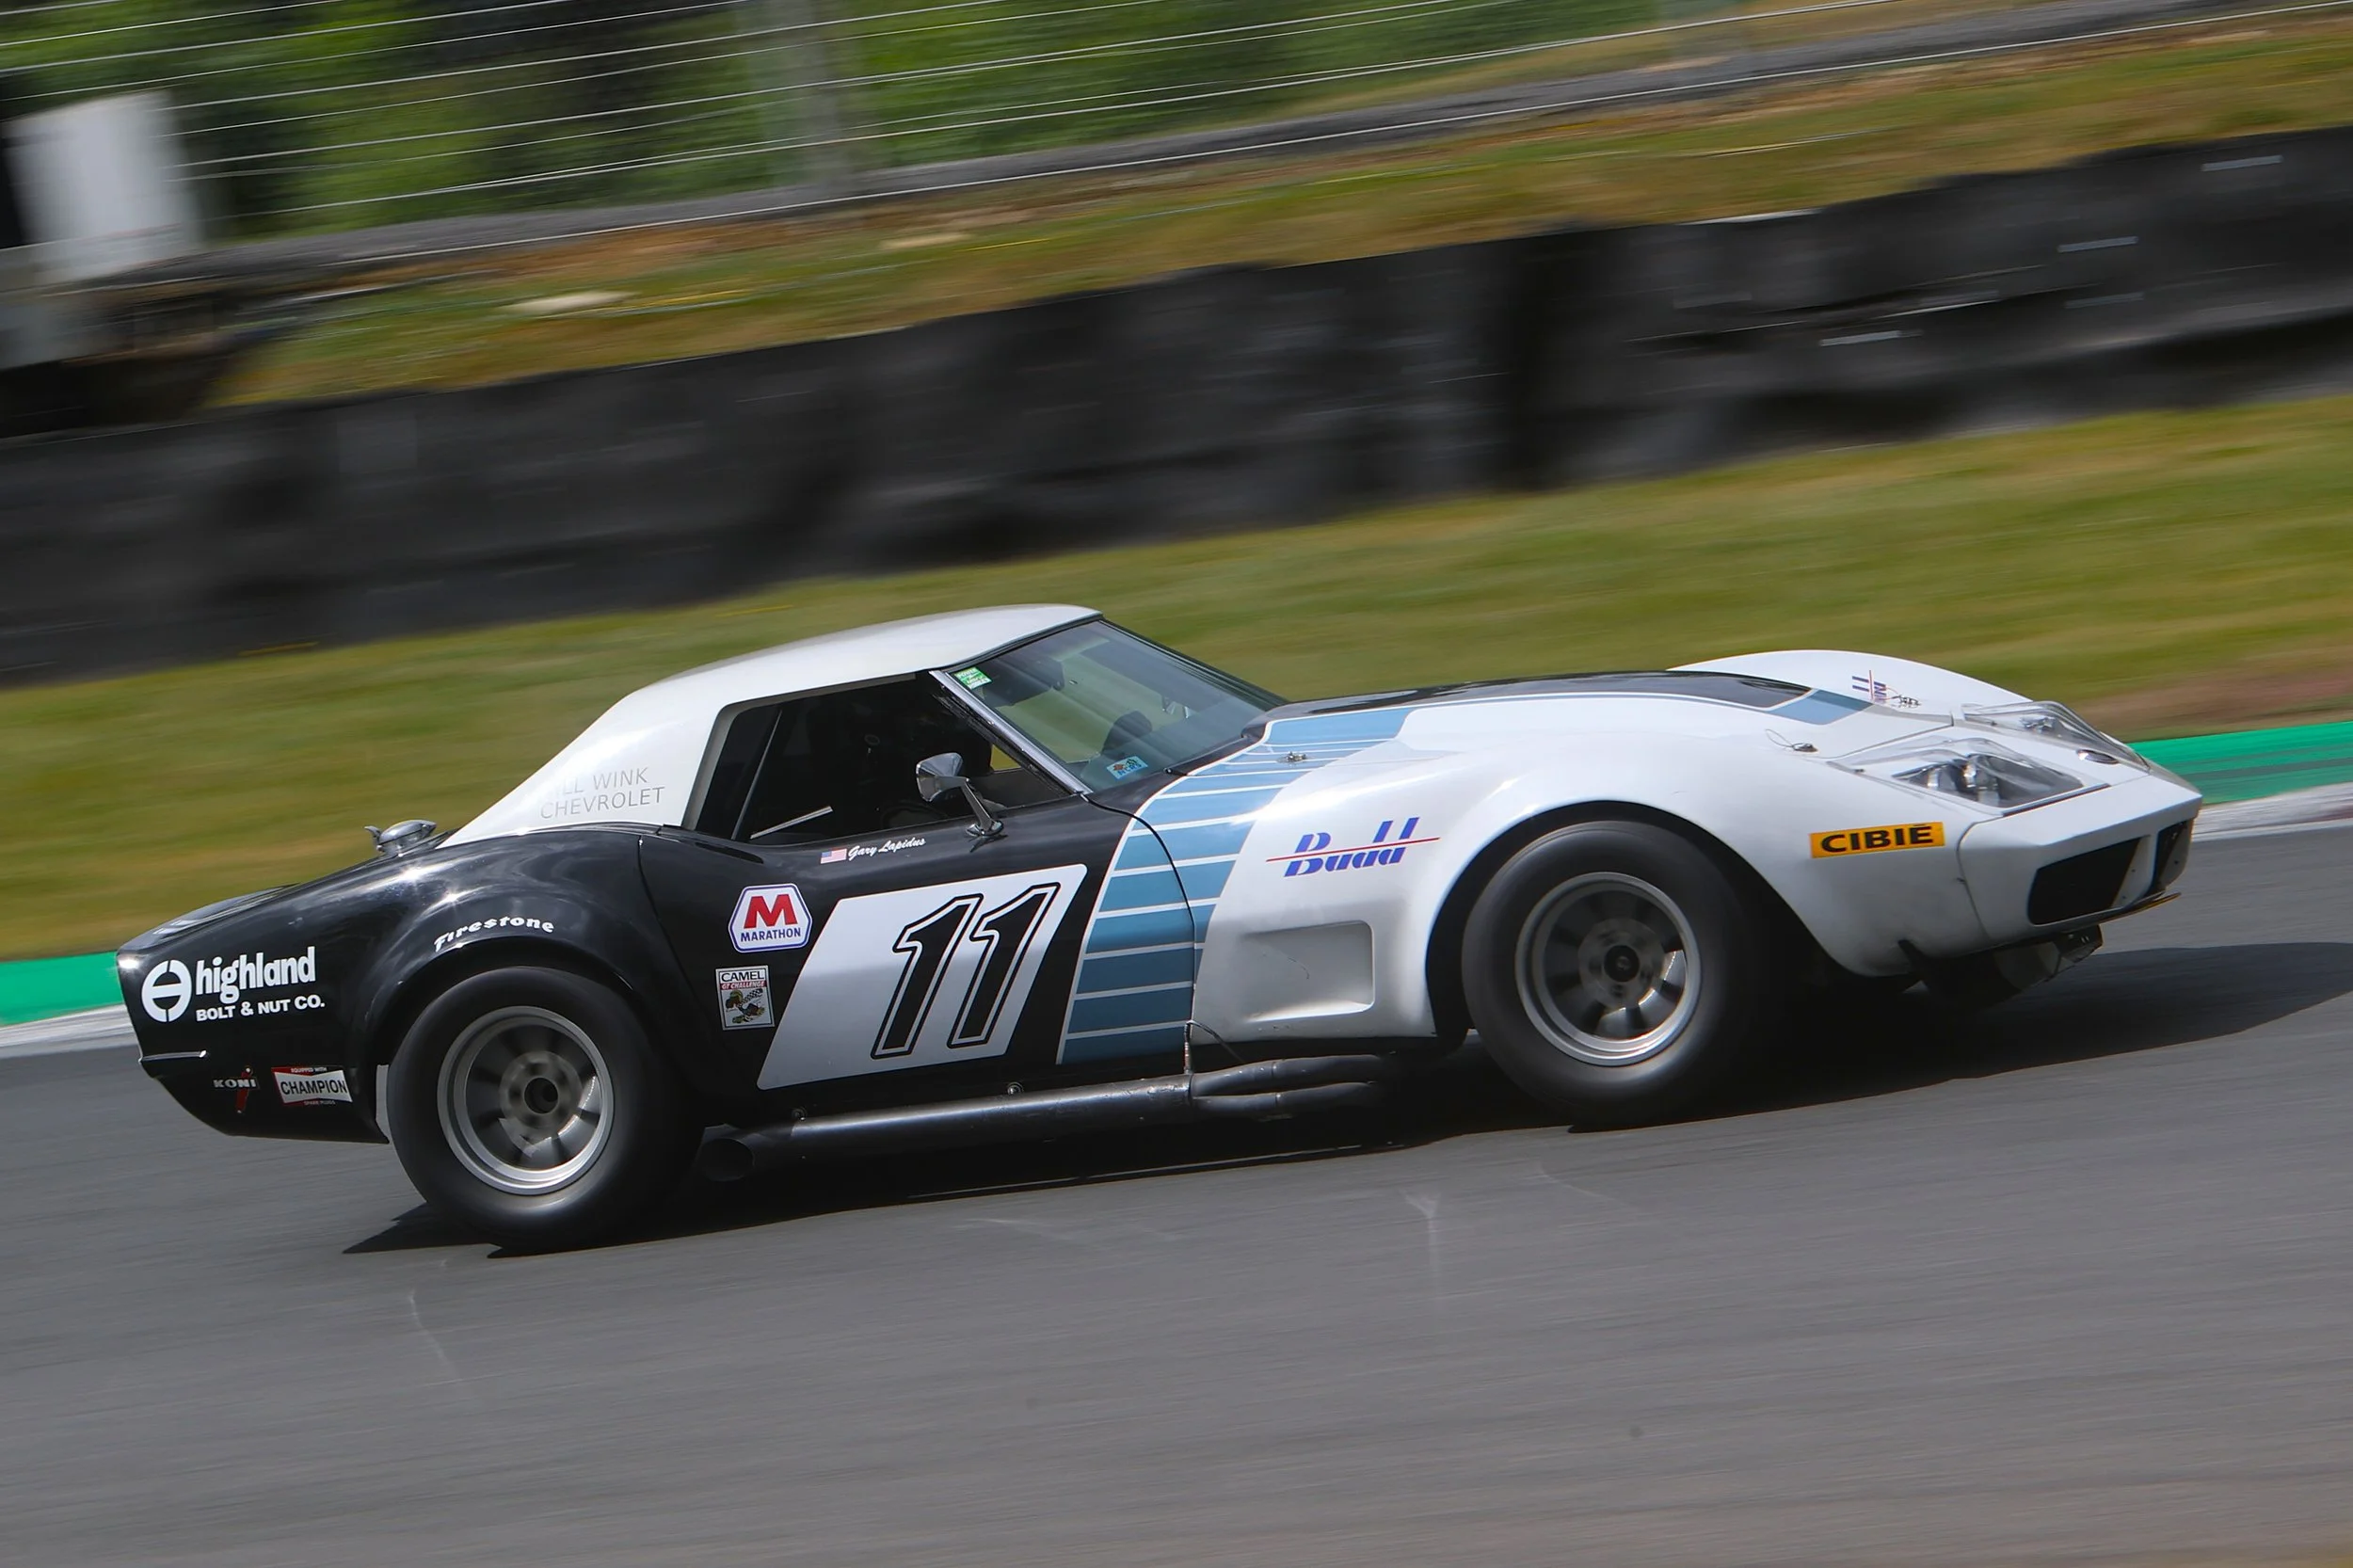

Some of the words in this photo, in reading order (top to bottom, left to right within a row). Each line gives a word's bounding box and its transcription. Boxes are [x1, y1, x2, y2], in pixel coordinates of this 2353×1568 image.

[593, 767, 648, 790] WINK
[540, 787, 664, 819] CHEVROLET
[848, 846, 877, 861] Gary
[878, 837, 926, 853] Lapidus
[1284, 817, 1420, 877] Budd
[744, 894, 798, 929] M
[434, 916, 554, 952] Firestone
[741, 927, 801, 942] MARATHON
[196, 946, 316, 1004] highland
[721, 970, 764, 982] CAMEL
[871, 882, 1061, 1060] 11
[196, 1006, 235, 1021] BOLT
[240, 1000, 253, 1016] &
[258, 999, 291, 1015] NUT
[294, 994, 326, 1010] CO.
[213, 1079, 257, 1089] KONI
[281, 1080, 348, 1095] CHAMPION
